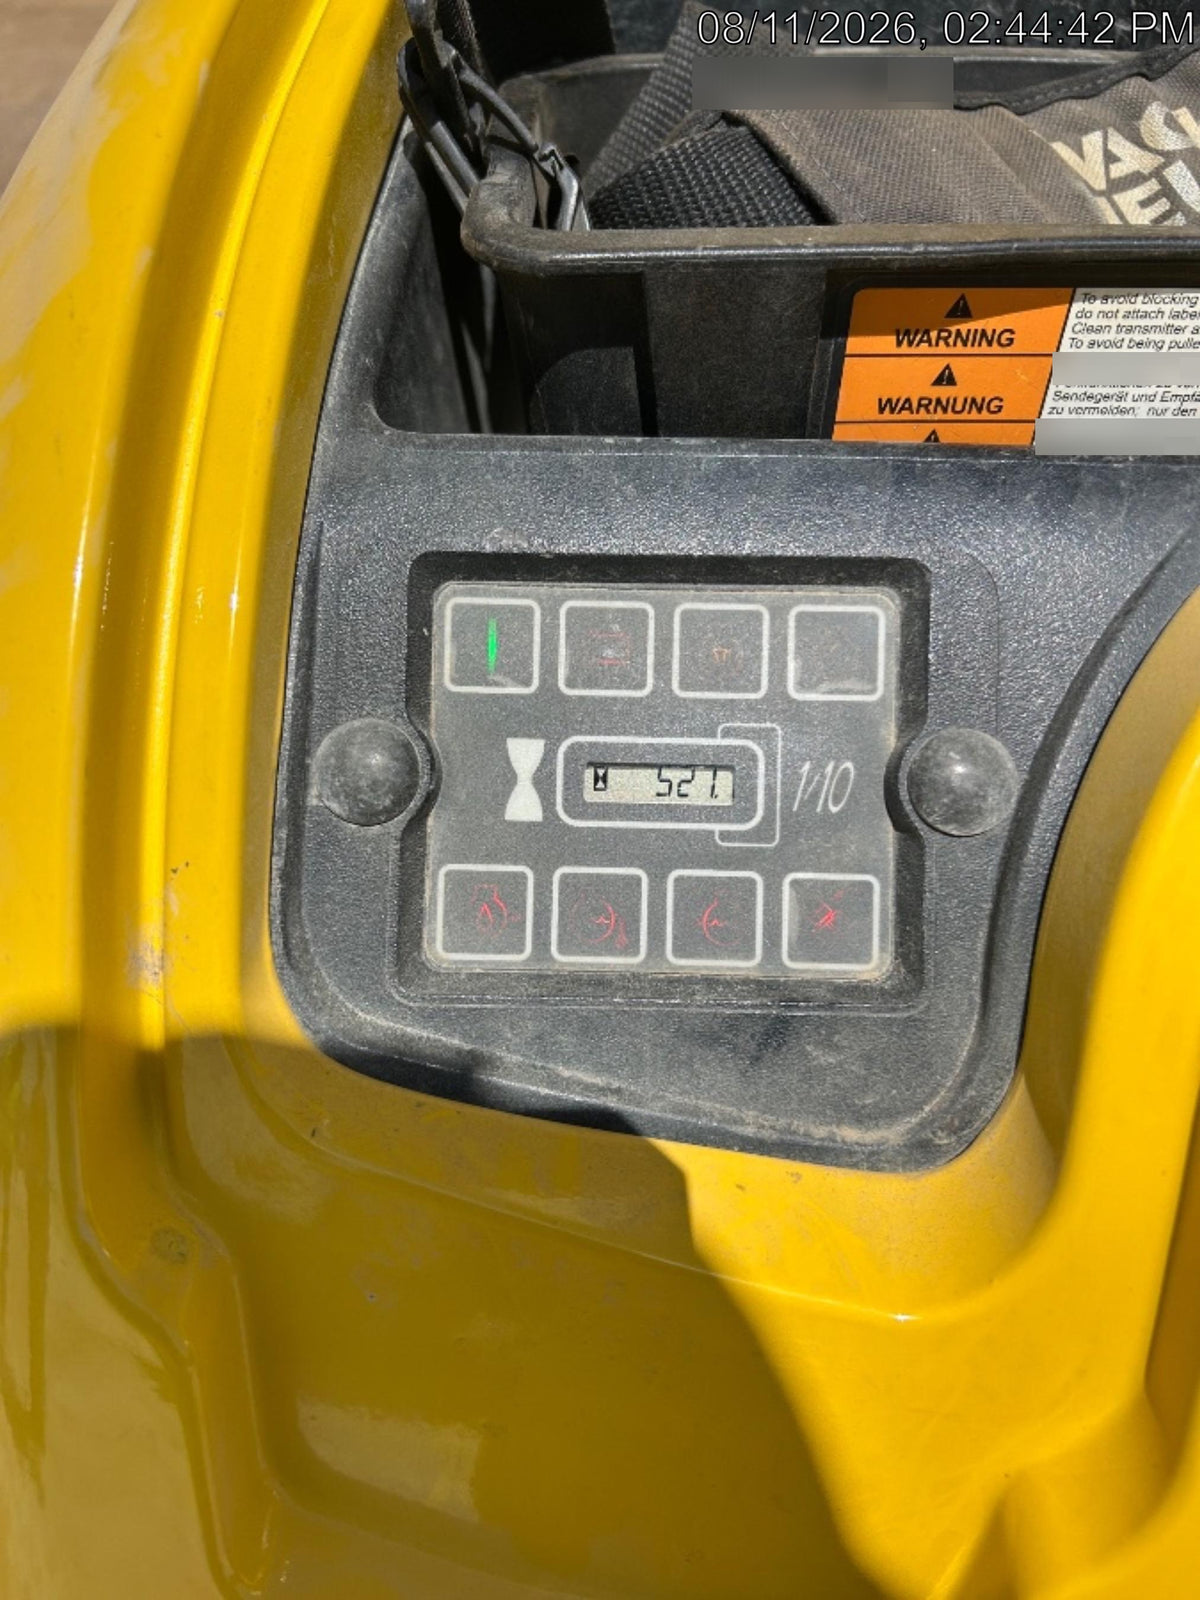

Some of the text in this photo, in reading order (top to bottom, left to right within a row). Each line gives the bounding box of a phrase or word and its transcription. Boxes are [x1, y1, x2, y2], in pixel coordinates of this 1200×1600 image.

[1081, 292, 1199, 308] To avoid blocking
[1075, 308, 1092, 319] do
[1097, 309, 1119, 319] not
[1122, 308, 1164, 319] attach
[1071, 322, 1112, 335] Clean
[1115, 322, 1188, 335] transmitter
[895, 328, 1016, 348] WARNING
[1069, 337, 1083, 349] To
[1087, 338, 1124, 349] avoid
[1127, 337, 1165, 352] being
[1052, 390, 1128, 404] Sendegerät
[1131, 391, 1157, 402] und
[877, 396, 1004, 415] WARNUNG
[1047, 406, 1064, 415] zu
[1146, 407, 1169, 416] nur
[792, 760, 855, 814] 1/10
